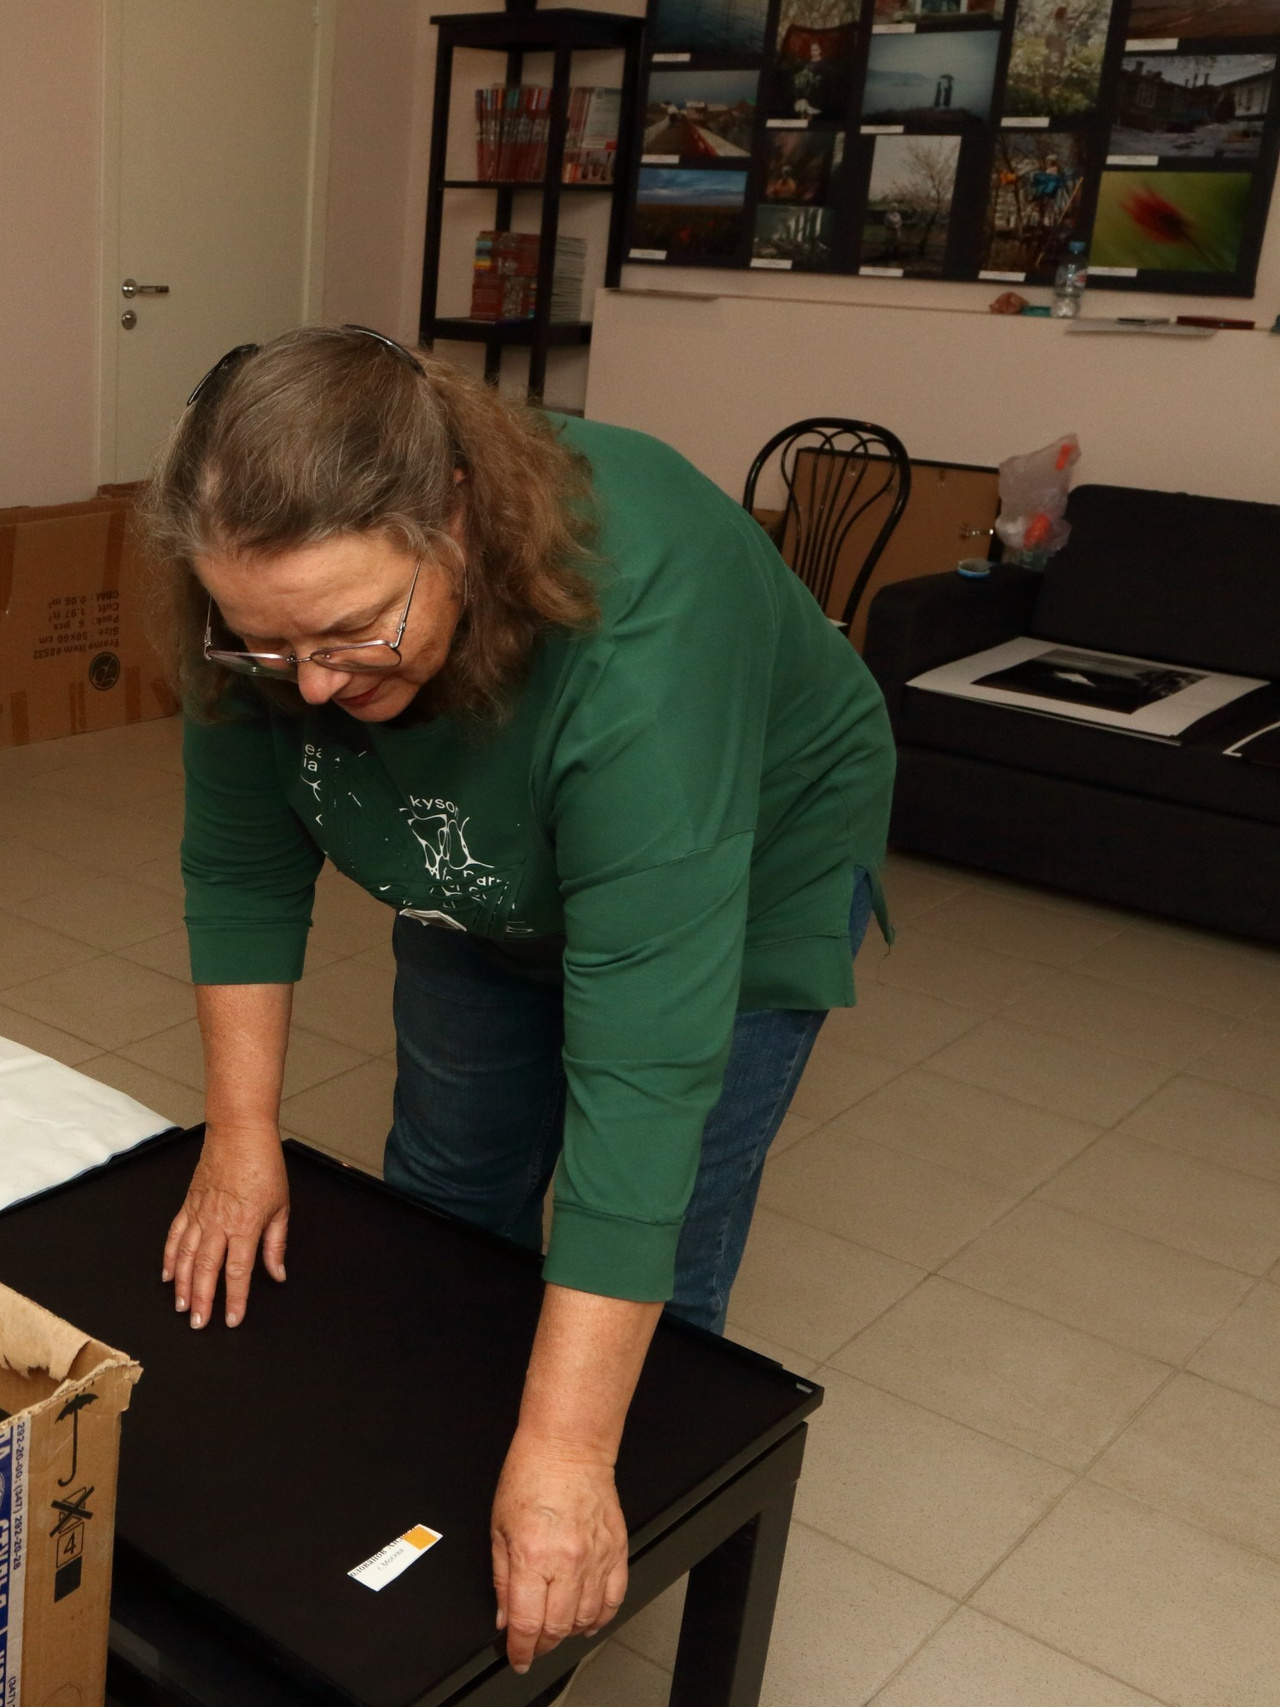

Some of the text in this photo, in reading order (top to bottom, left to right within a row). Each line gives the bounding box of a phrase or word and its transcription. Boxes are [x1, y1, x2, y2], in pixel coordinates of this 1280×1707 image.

[96, 614, 119, 626] Pack
[38, 626, 119, 644] Size 50x60 cm
[88, 638, 119, 650] Frame
[12, 1484, 23, 1514] (347)
[12, 1515, 23, 1571] 292-20-28
[64, 1532, 77, 1555] 4
